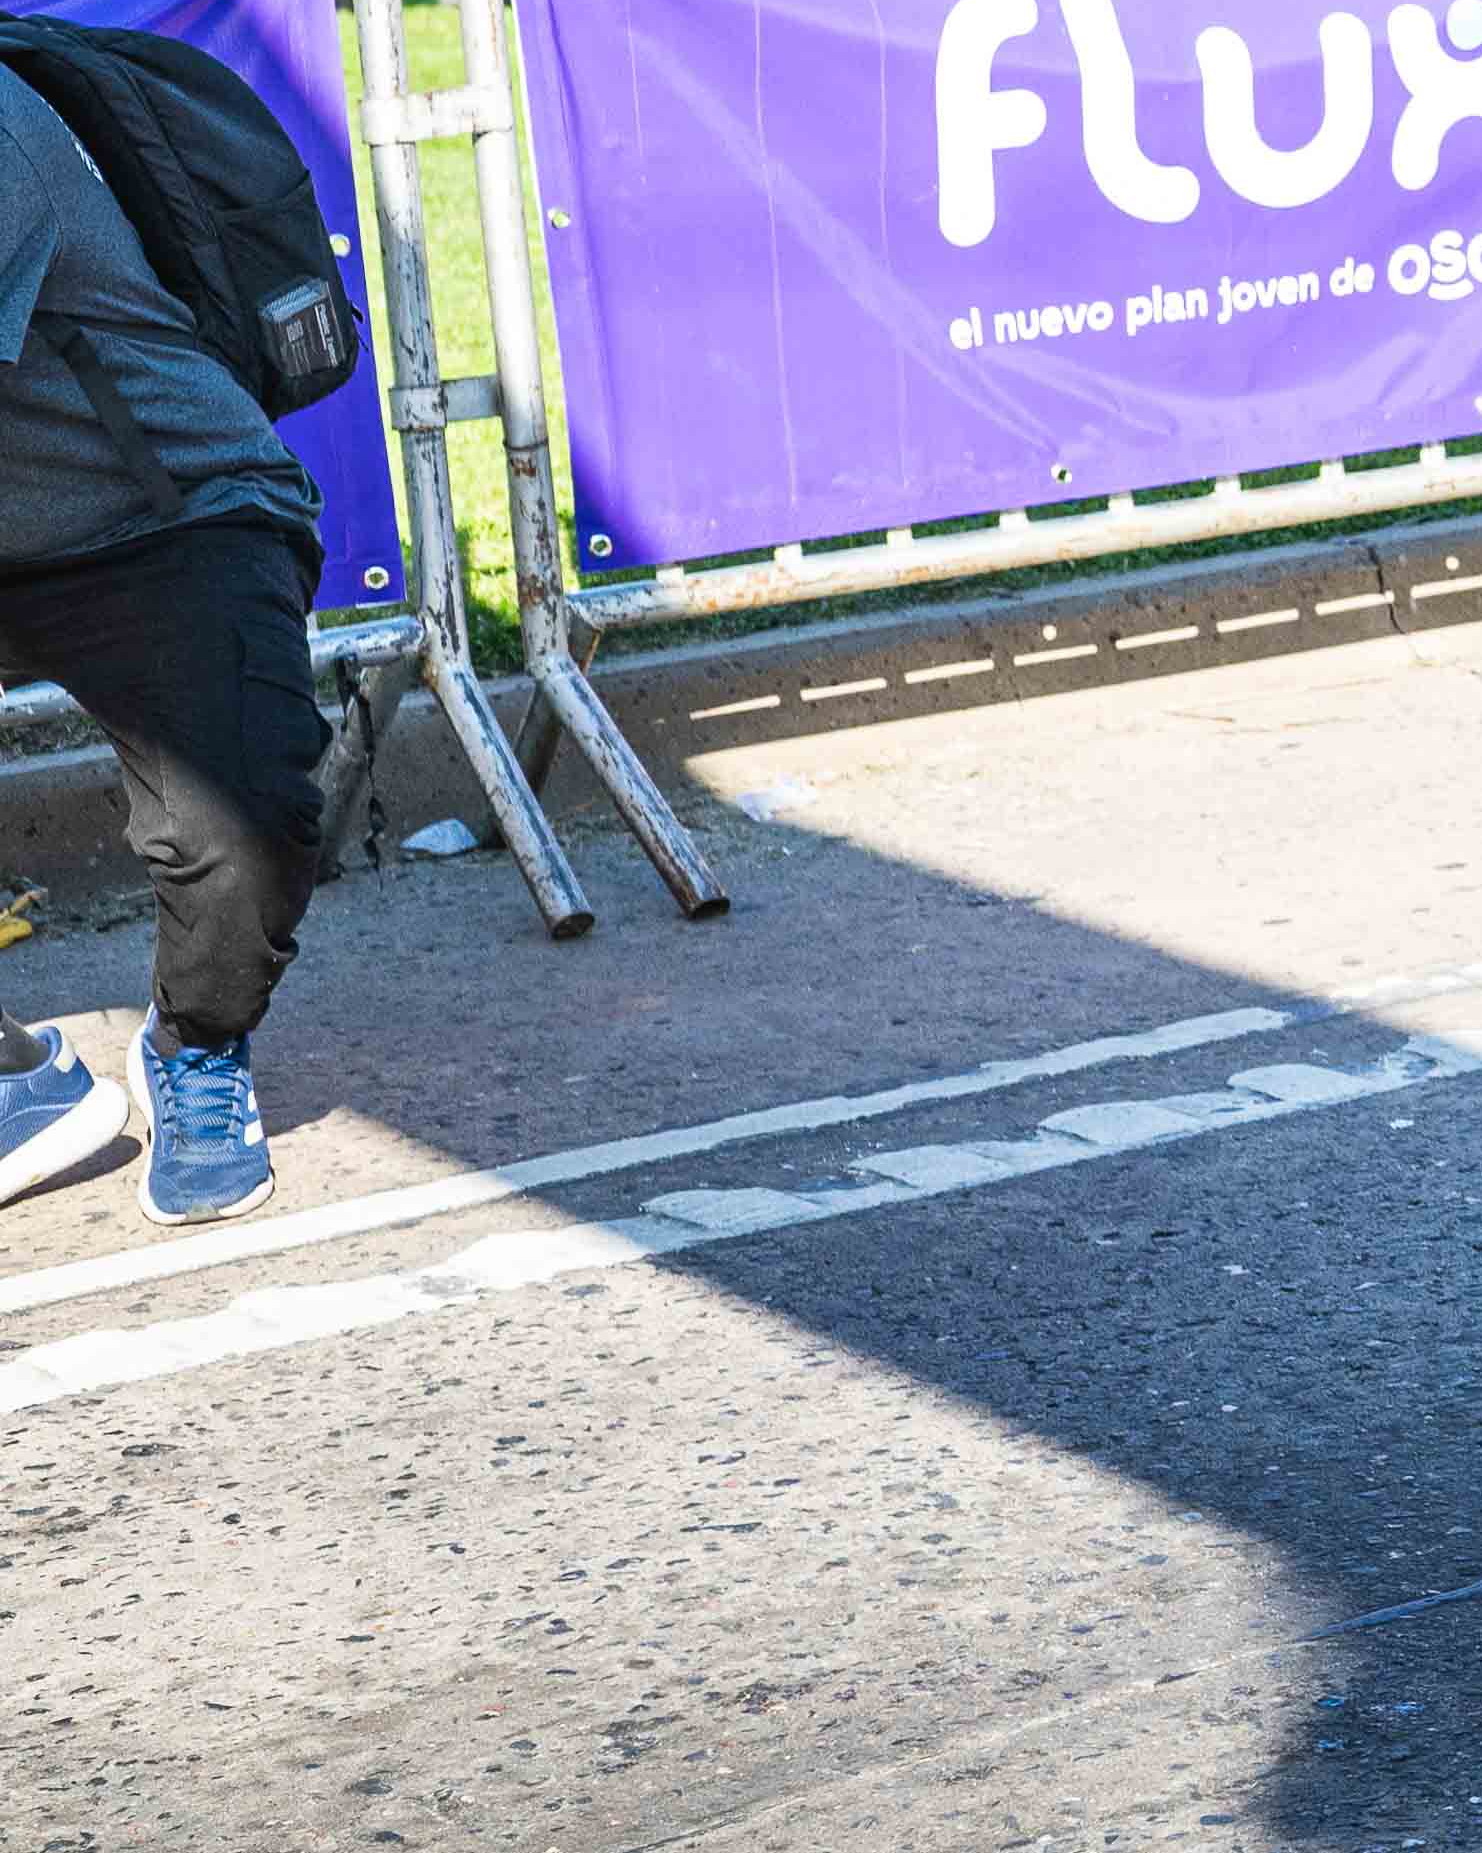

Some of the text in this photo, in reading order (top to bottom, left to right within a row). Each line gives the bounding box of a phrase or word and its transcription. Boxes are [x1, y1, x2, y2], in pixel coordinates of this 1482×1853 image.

[949, 306, 983, 350] el
[993, 299, 1114, 345] nuevo
[1126, 284, 1208, 336] plan
[1217, 269, 1319, 325] joven
[1329, 257, 1375, 299] de
